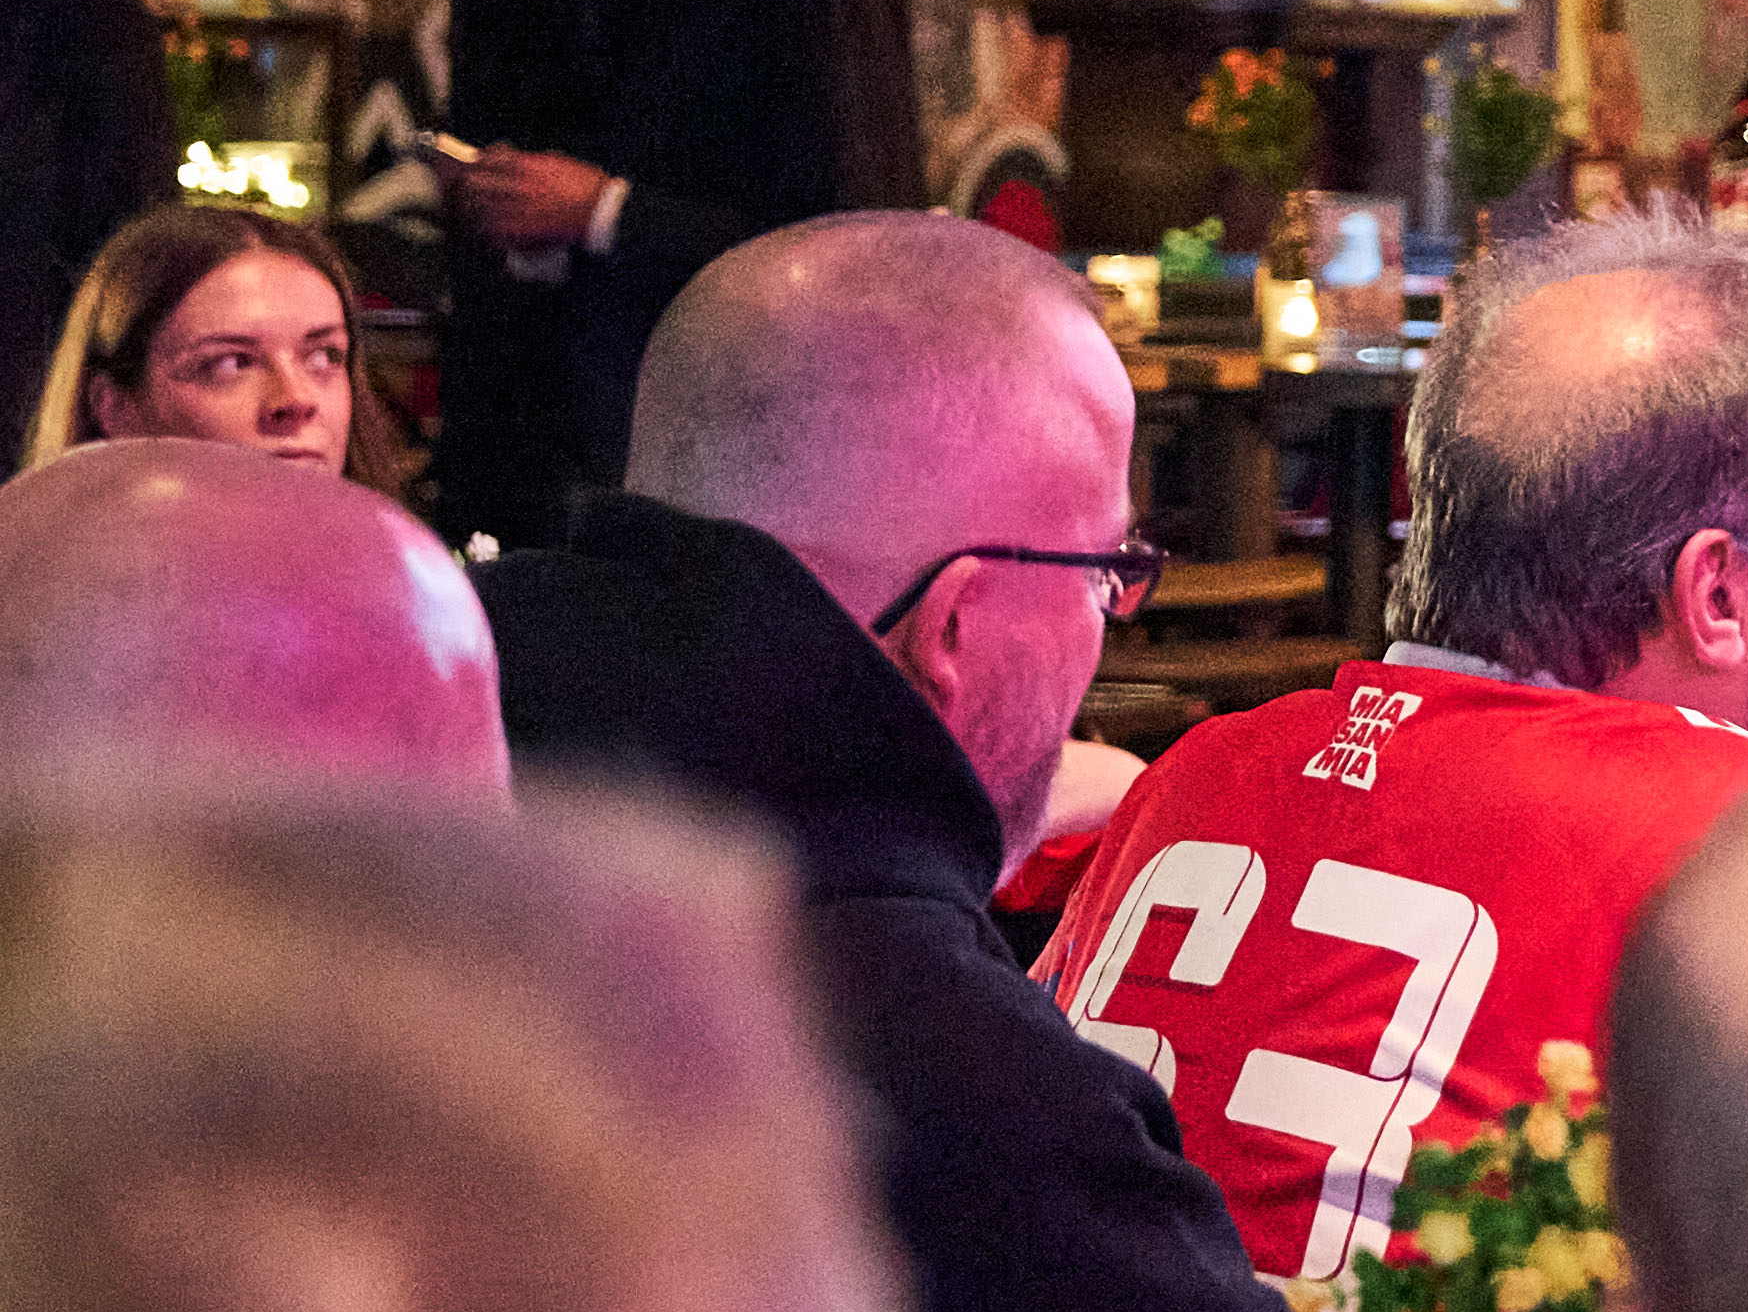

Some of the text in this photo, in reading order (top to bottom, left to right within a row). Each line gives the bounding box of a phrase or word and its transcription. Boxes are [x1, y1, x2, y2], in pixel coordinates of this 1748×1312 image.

[1350, 693, 1405, 725] MIA
[1332, 720, 1396, 751] SAN
[1313, 746, 1373, 781] MIA
